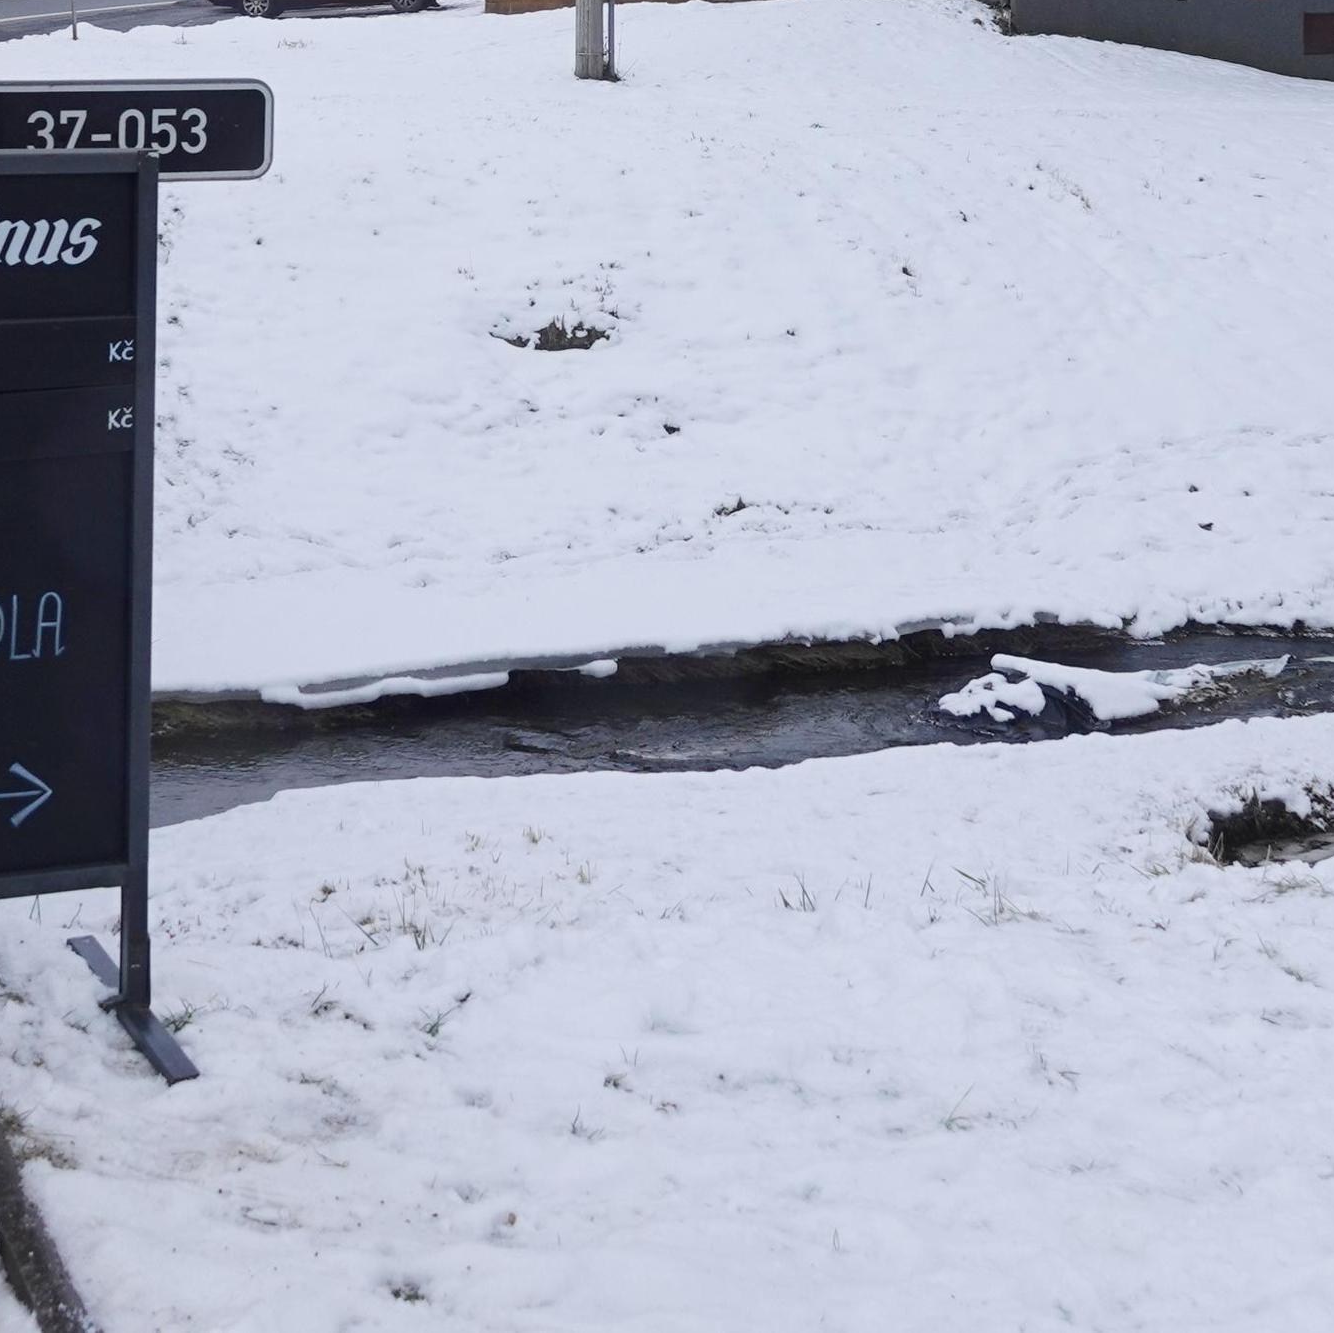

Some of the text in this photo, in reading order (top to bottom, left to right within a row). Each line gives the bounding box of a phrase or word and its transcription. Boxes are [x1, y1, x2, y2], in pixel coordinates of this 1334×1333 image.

[27, 108, 208, 155] 37-053
[108, 339, 134, 363] Kč
[107, 406, 133, 431] Kč
